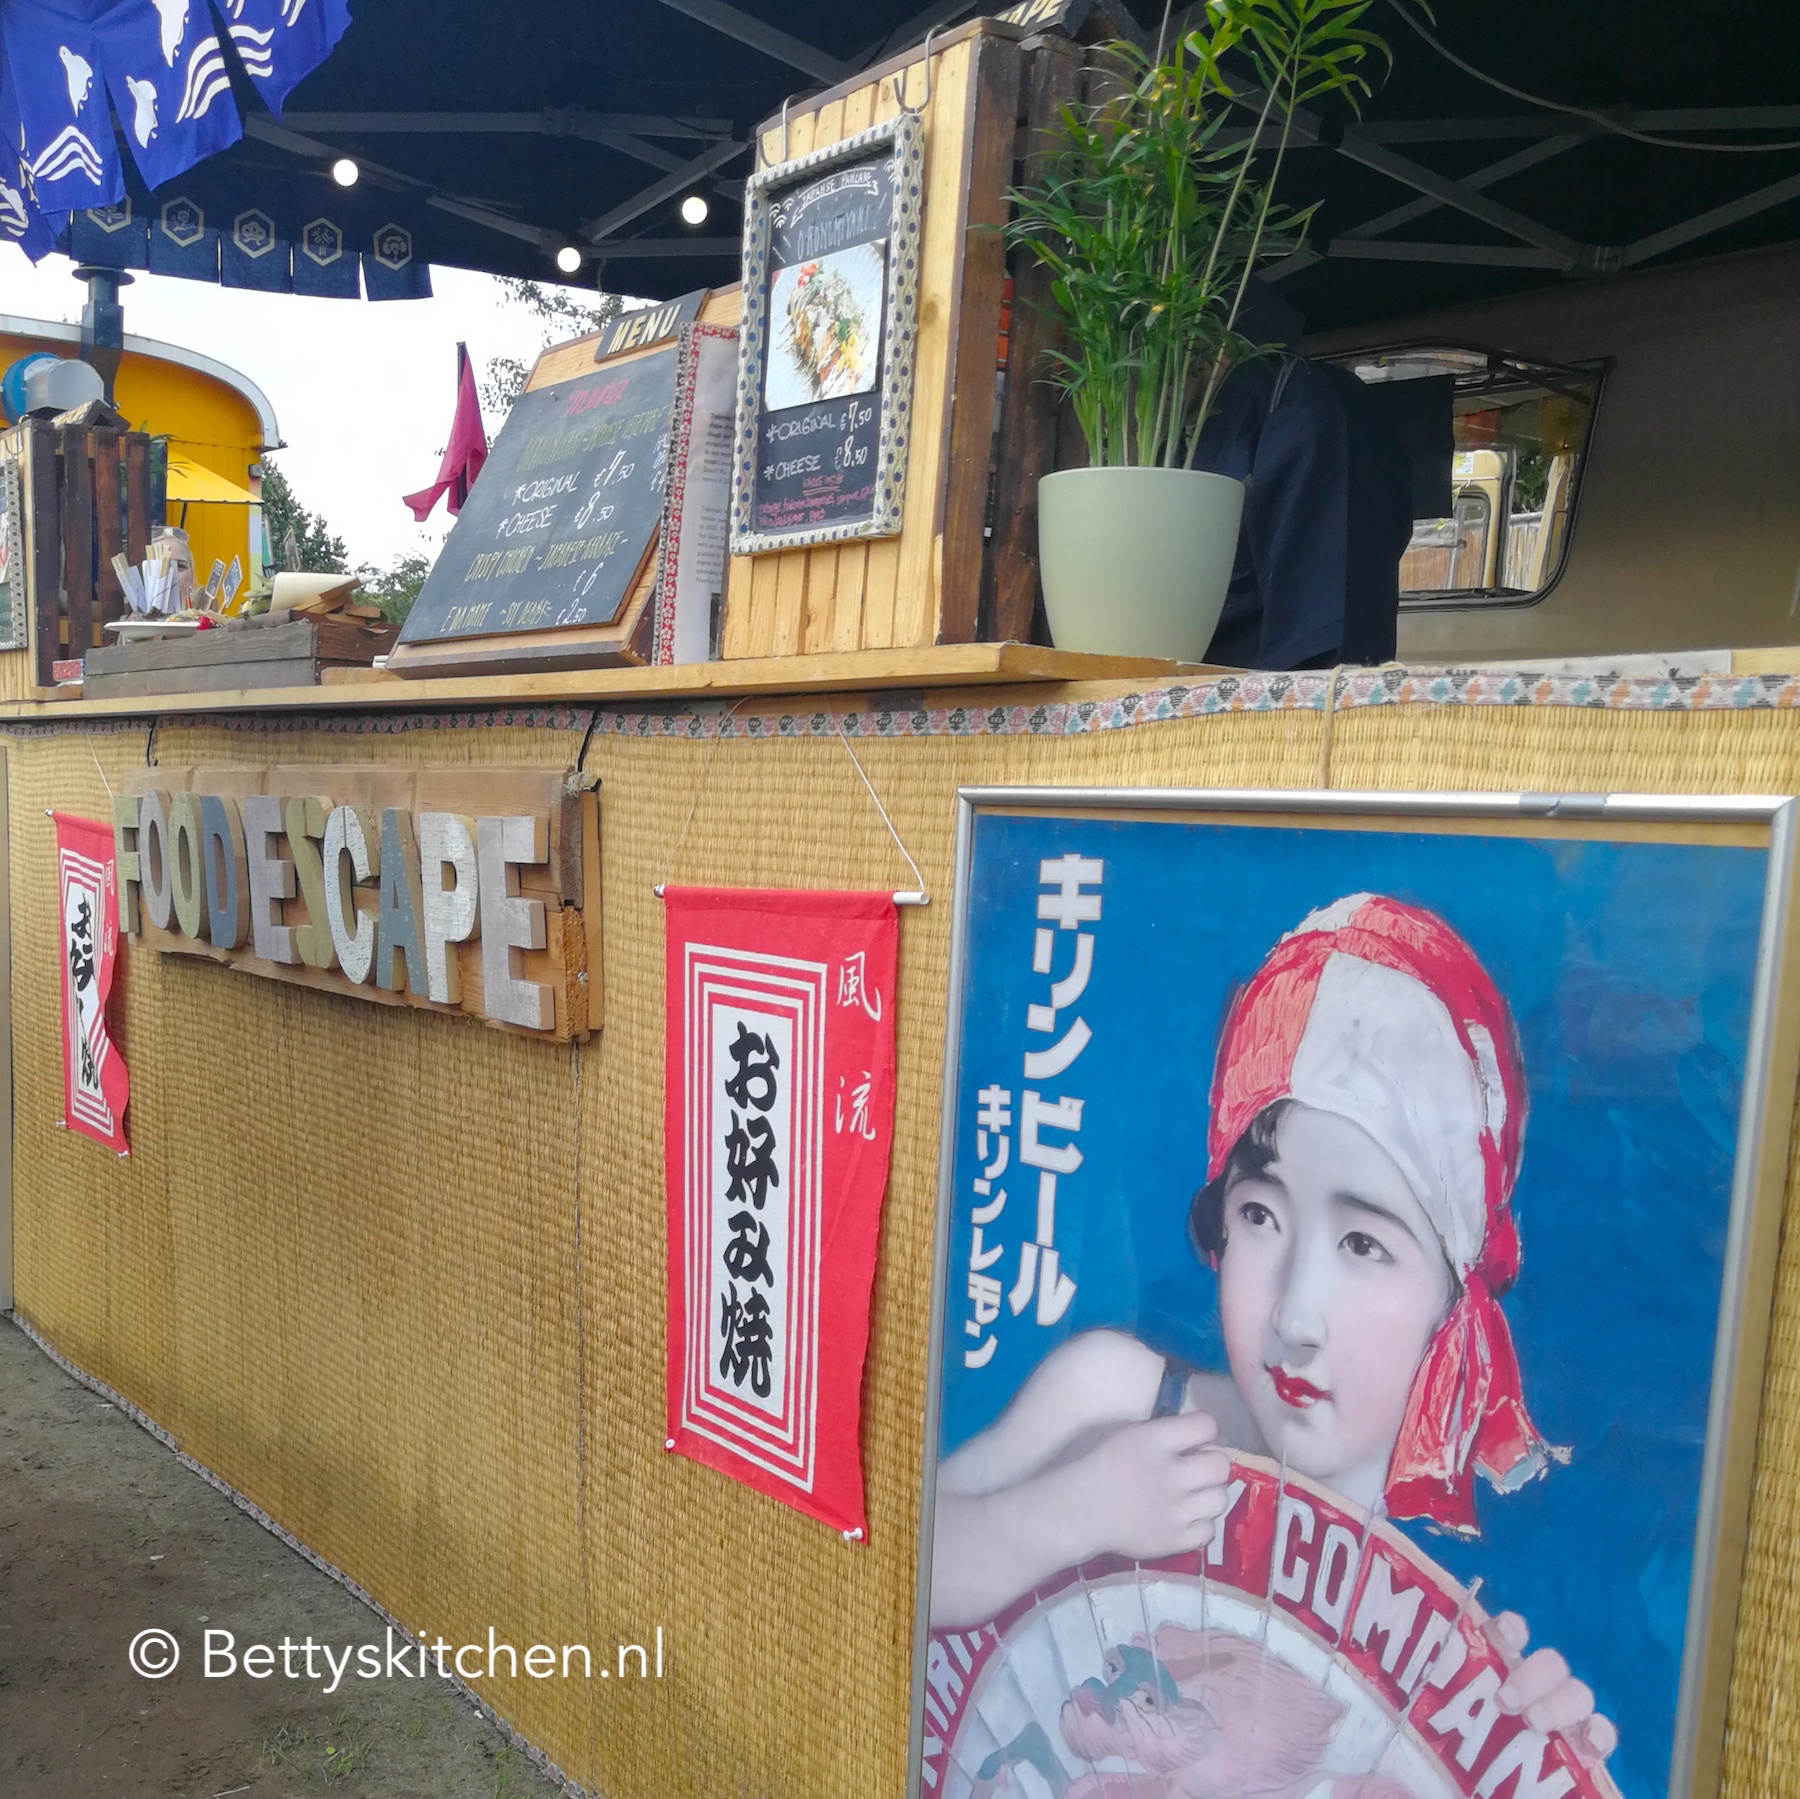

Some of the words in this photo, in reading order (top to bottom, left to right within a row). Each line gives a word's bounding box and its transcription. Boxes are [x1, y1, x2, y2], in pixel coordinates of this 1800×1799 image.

[606, 304, 683, 355] MENU
[719, 1019, 780, 1399] お好み焼
[964, 1084, 1012, 1369] キリンレモン
[1007, 852, 1104, 1327] キリンビール
